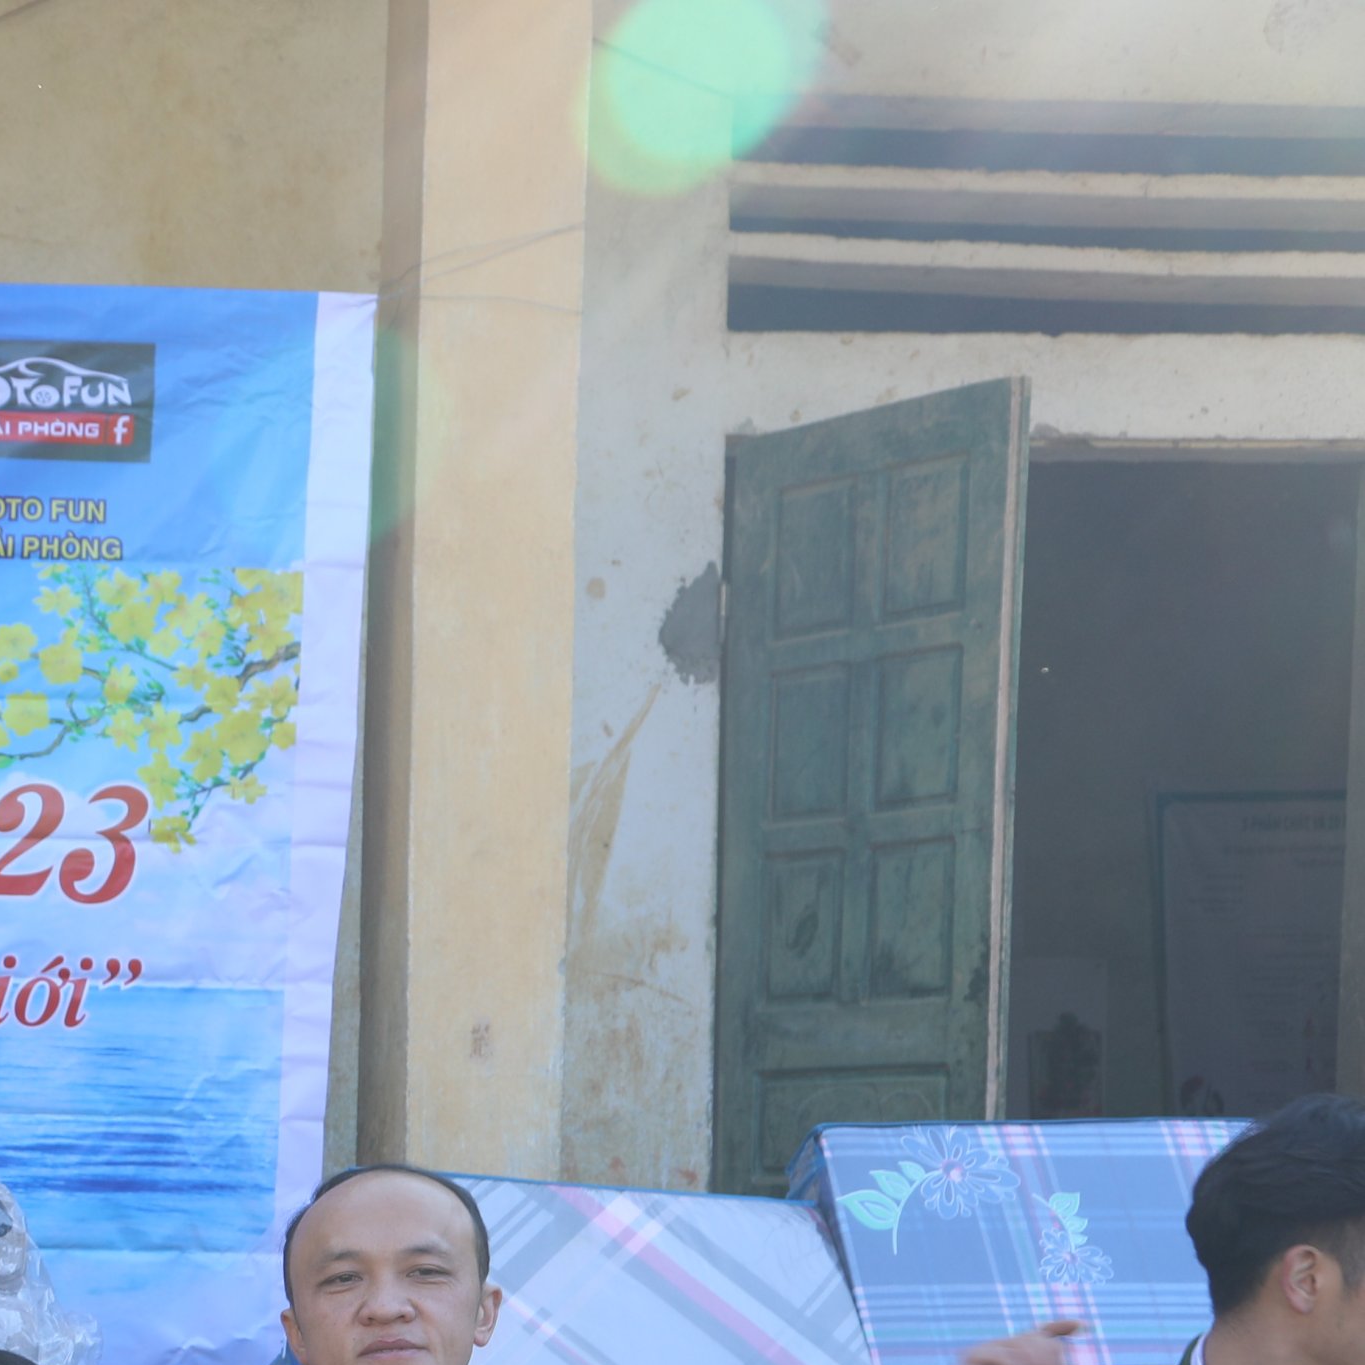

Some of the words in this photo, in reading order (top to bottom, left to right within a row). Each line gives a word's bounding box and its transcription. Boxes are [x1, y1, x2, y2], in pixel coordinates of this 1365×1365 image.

[18, 417, 100, 438] PHÒNG
[49, 498, 107, 525] FUN
[21, 530, 124, 562] PHÒNG
